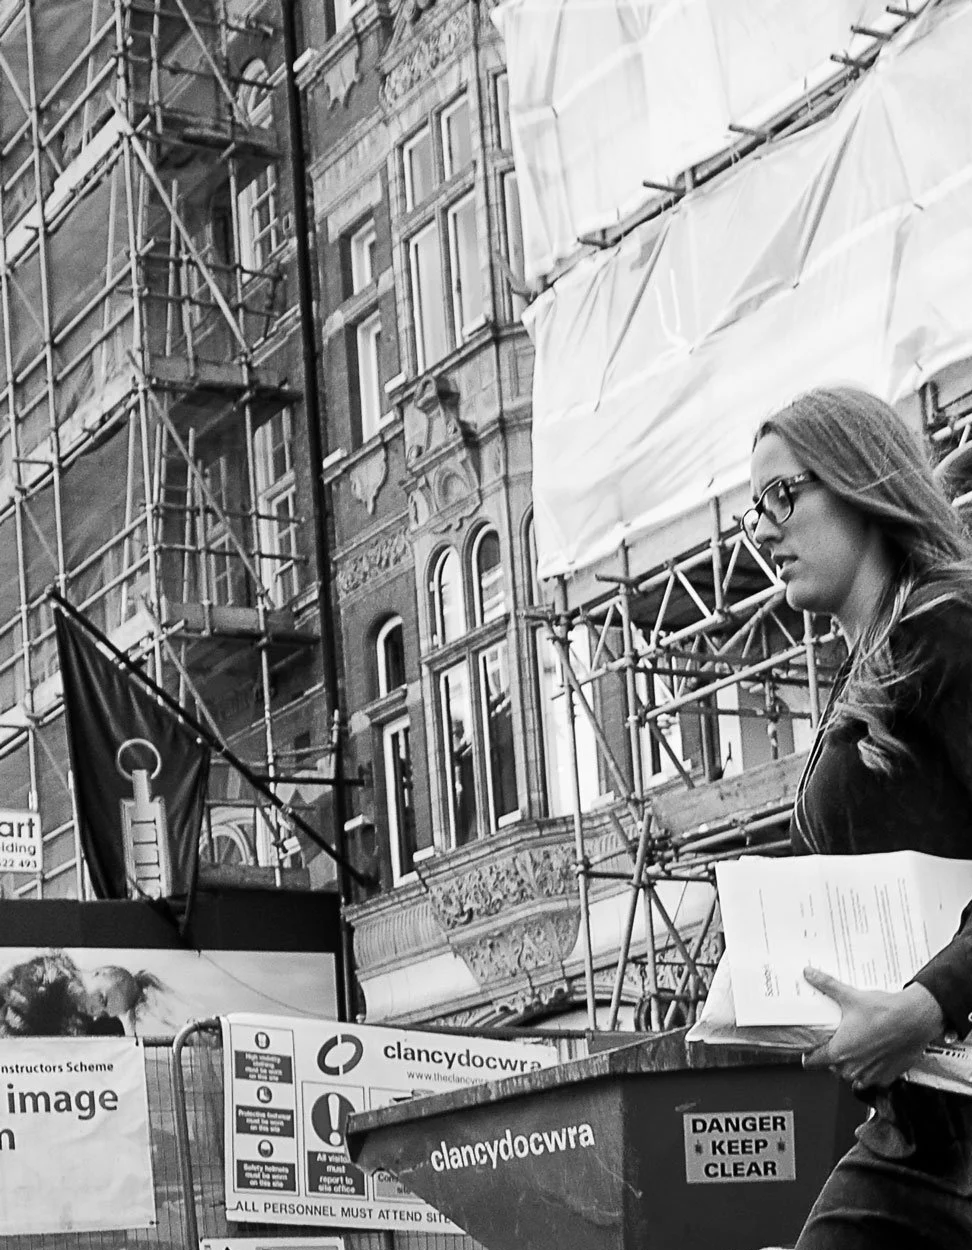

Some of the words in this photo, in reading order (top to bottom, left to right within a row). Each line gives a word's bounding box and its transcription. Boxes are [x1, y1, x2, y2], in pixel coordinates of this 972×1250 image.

[383, 1041, 542, 1072] clancydocwra
[1, 1063, 63, 1074] nstructors
[66, 1061, 114, 1073] Scheme
[7, 1083, 119, 1120] image
[691, 1115, 787, 1134] DANGER
[431, 1123, 596, 1172] clancydocwra
[711, 1138, 769, 1156] KEEP
[327, 1154, 351, 1164] visito
[704, 1161, 778, 1178] CLEAR
[235, 1201, 259, 1213] ALL
[263, 1202, 337, 1217] PERSONNEL
[341, 1206, 373, 1219] MUST
[377, 1209, 422, 1222] ATTEND
